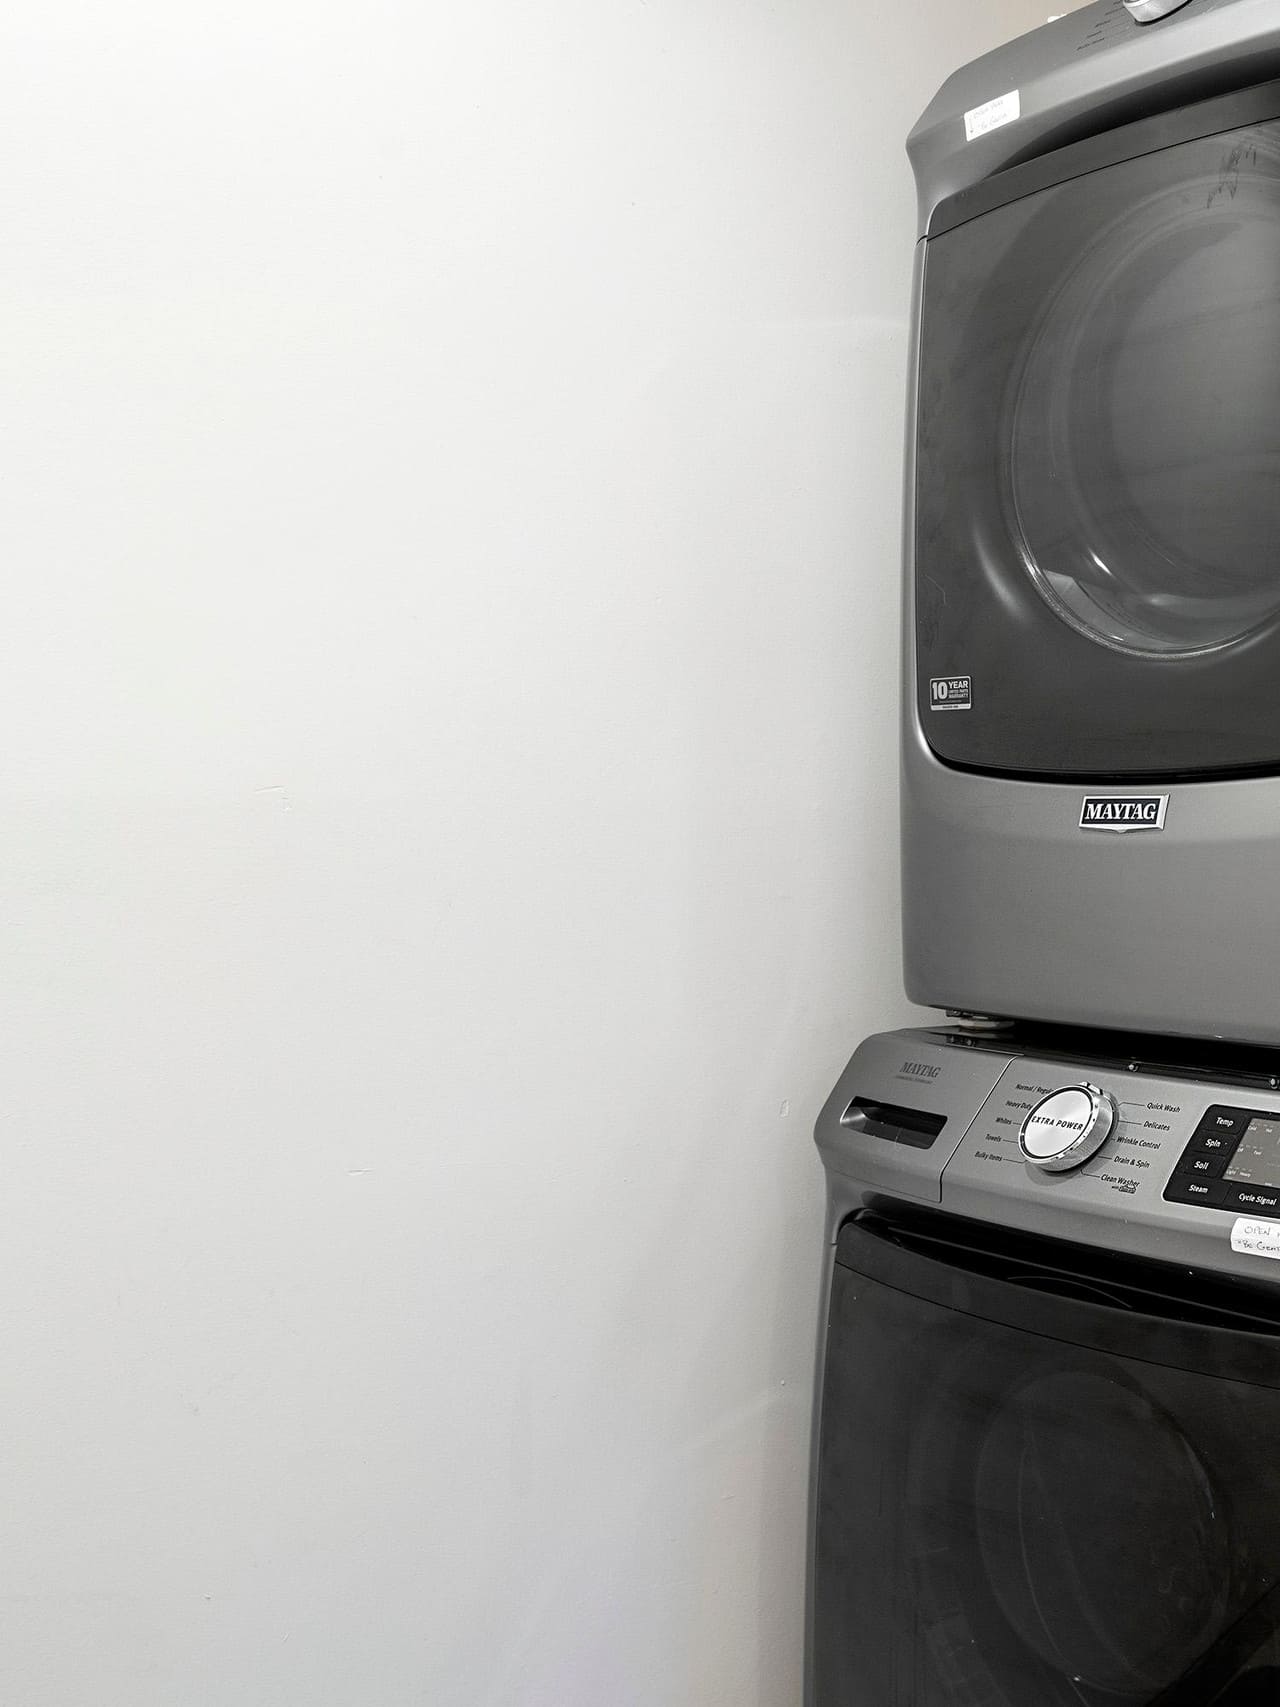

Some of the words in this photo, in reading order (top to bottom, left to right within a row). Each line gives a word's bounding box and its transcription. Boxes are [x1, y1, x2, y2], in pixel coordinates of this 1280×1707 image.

[932, 681, 948, 700] 10
[948, 680, 969, 689] YEAR
[1084, 803, 1157, 820] MAYTAG
[899, 1062, 941, 1078] MAYTAG
[1146, 1102, 1163, 1111] Quick
[1163, 1104, 1181, 1113] Wash
[1031, 1116, 1055, 1126] EXTRA
[1056, 1119, 1083, 1131] POWER
[1143, 1120, 1171, 1131] Delicates
[1216, 1116, 1234, 1128] Temp
[1116, 1136, 1139, 1146] Wrinkle
[1138, 1139, 1161, 1149] Control
[1205, 1138, 1221, 1148] Spin
[1113, 1155, 1129, 1165] Drain
[1129, 1158, 1135, 1166] &
[1136, 1159, 1150, 1169] Spin
[1194, 1160, 1210, 1170] Soil
[1101, 1173, 1118, 1183] Clean
[1118, 1177, 1140, 1186] Washer
[1188, 1184, 1209, 1194] Steam
[1238, 1193, 1256, 1202] Cycle
[1255, 1196, 1278, 1206] Signal
[1244, 1226, 1271, 1236] OPEN
